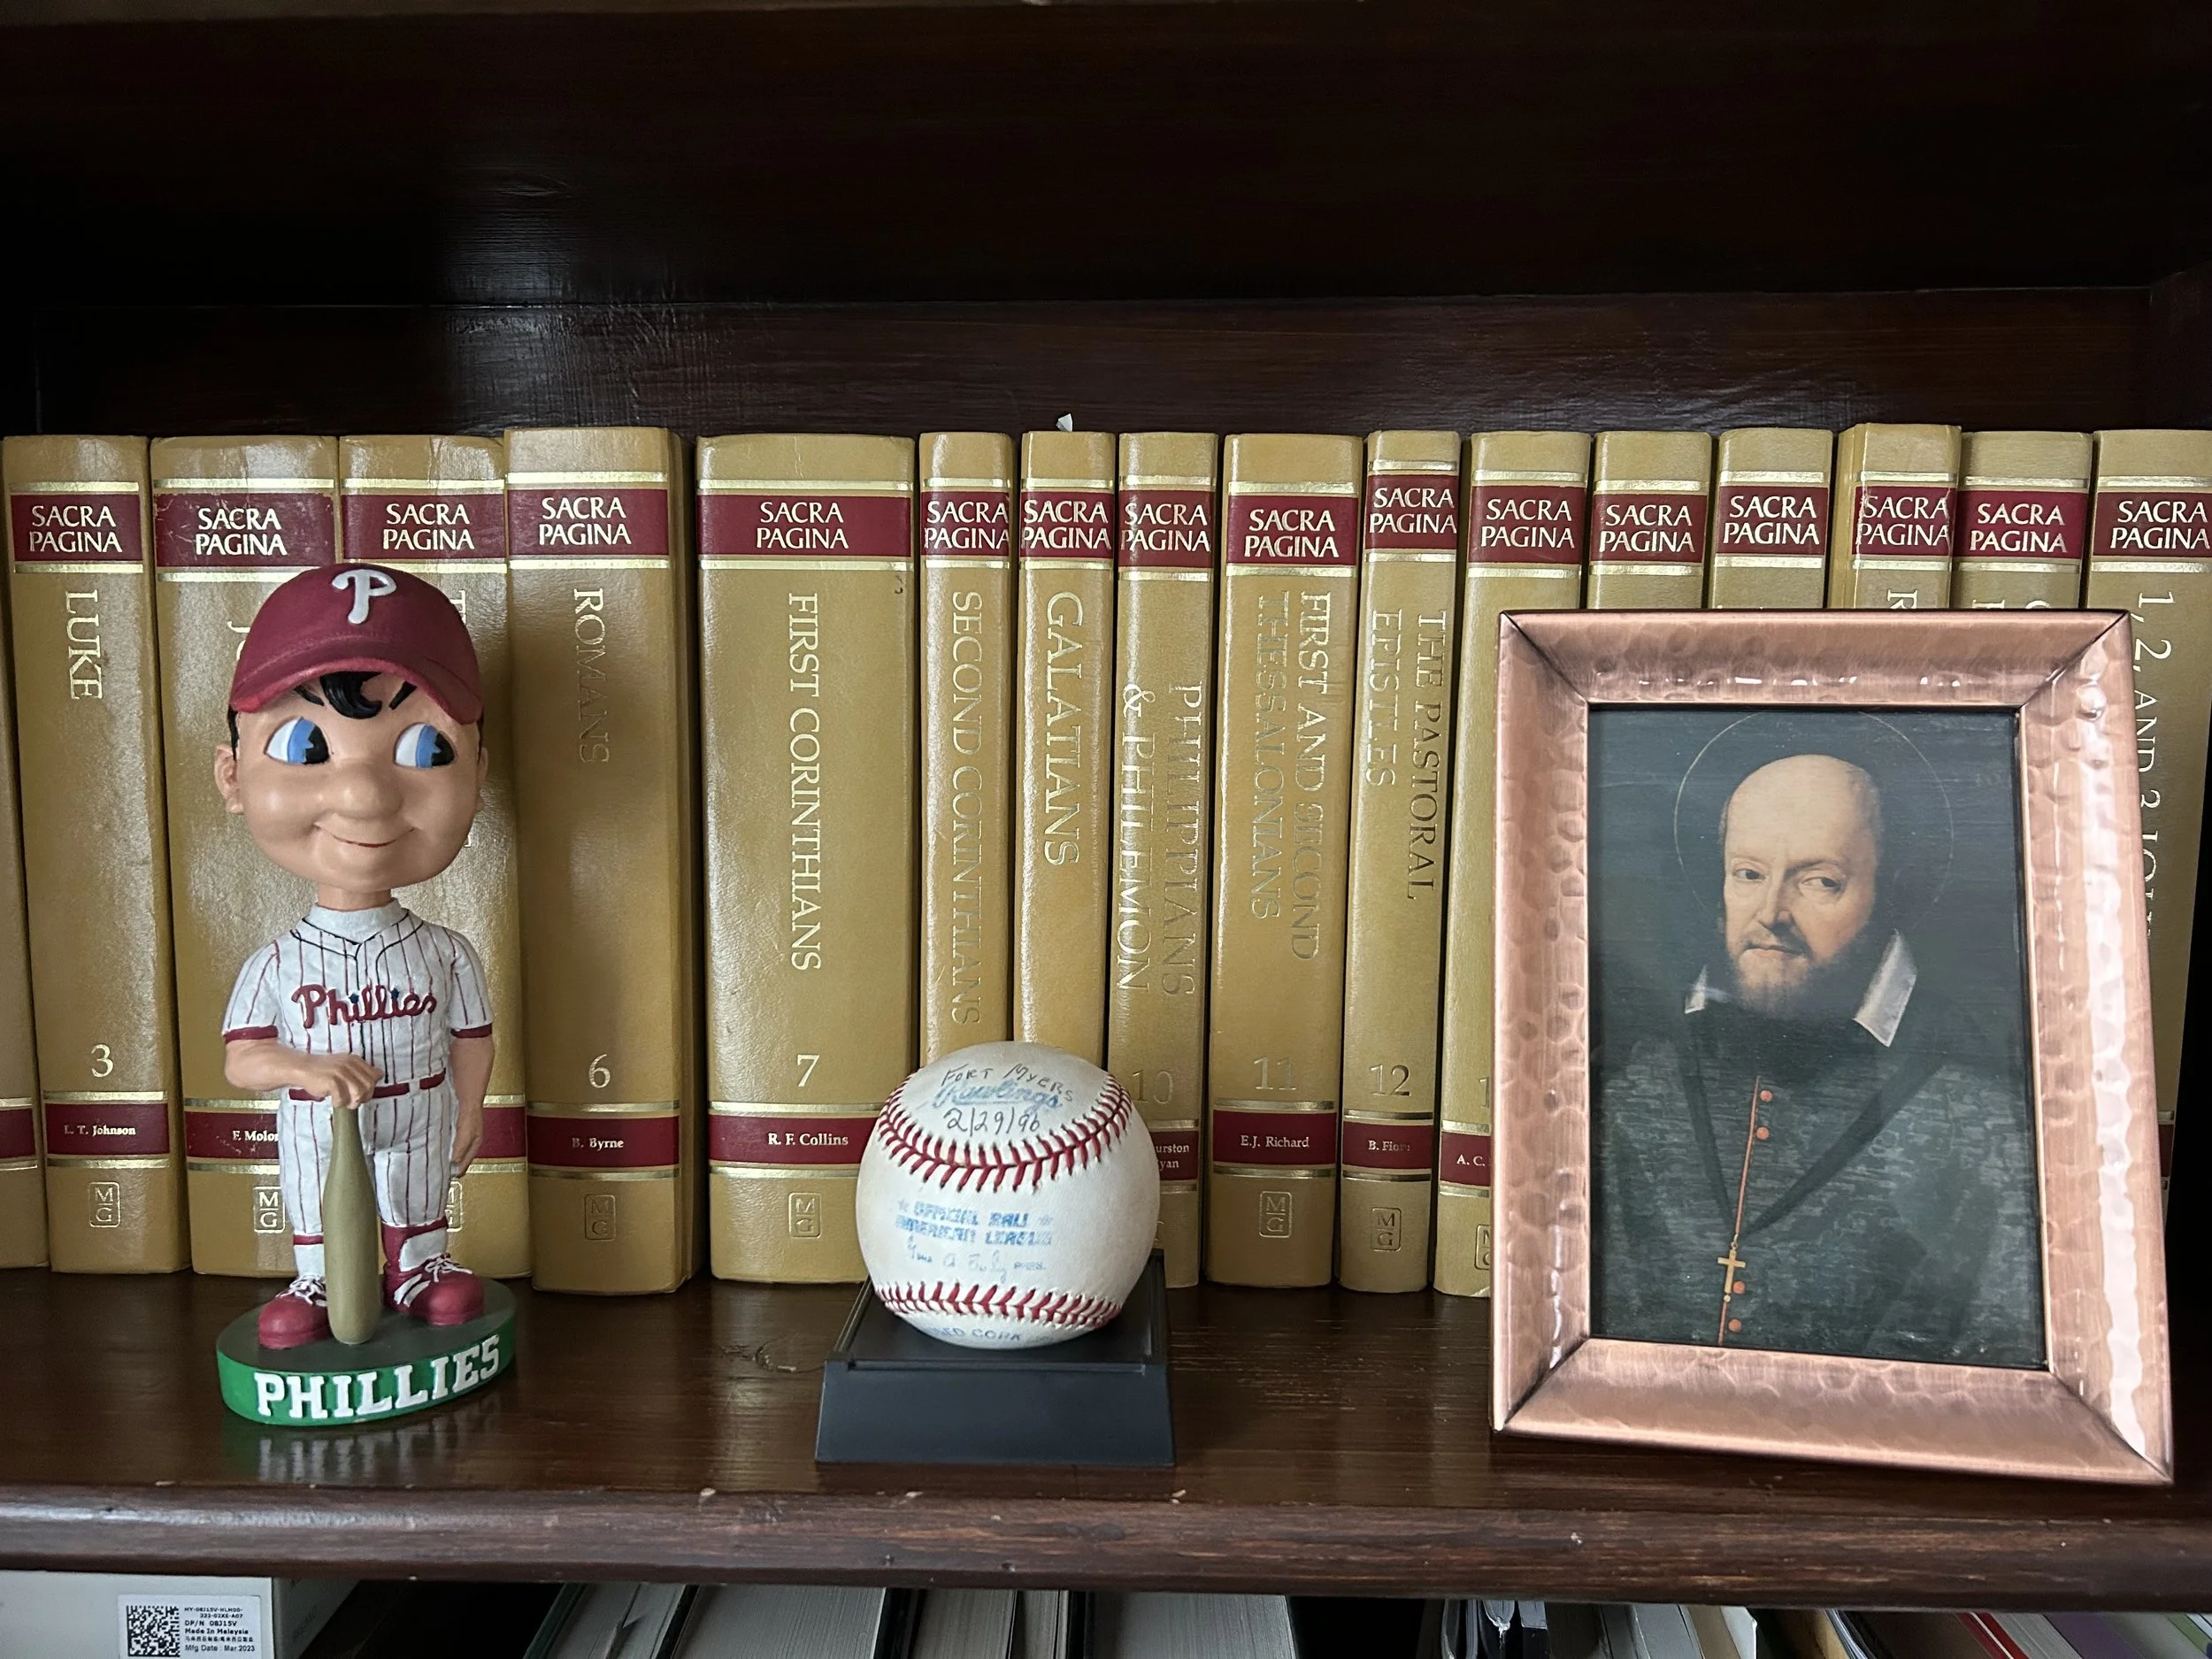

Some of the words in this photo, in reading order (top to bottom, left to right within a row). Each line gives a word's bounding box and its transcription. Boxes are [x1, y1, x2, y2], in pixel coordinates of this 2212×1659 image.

[542, 497, 626, 519] SACRA
[1373, 488, 1454, 508] SACRA
[1730, 496, 1816, 518] SACRA
[1863, 495, 1948, 518] SACRA
[33, 506, 116, 526] SACRA
[197, 507, 281, 530] SACRA
[387, 503, 470, 525] SACRA
[761, 502, 843, 523] SACRA
[927, 501, 1008, 524] SACRA
[1024, 500, 1108, 523] SACRA
[1125, 502, 1207, 526] SACRA
[1249, 510, 1335, 531] SACRA
[1486, 499, 1571, 521] SACRA
[1606, 504, 1692, 526] SACRA
[1978, 503, 2063, 525] SACRA
[2118, 501, 2207, 523] SACRA
[1370, 511, 1456, 533] PAGINA
[1724, 522, 1819, 544] PAGINA
[30, 532, 122, 552] PAGINA
[196, 534, 287, 556] PAGINA
[383, 529, 474, 550] PAGINA
[540, 523, 632, 545] PAGINA
[757, 528, 849, 549] PAGINA
[925, 526, 1010, 550] PAGINA
[1022, 526, 1111, 549] PAGINA
[1121, 528, 1210, 552] PAGINA
[1480, 526, 1574, 548] PAGINA
[1600, 530, 1694, 552] PAGINA
[1857, 522, 1949, 546] PAGINA
[1970, 531, 2066, 552] PAGINA
[2111, 527, 2211, 549] PAGINA
[1245, 535, 1339, 557] PAGINA
[65, 589, 104, 700] LUKE
[787, 592, 820, 697] FIRST
[1297, 590, 1331, 695] FIRST
[1416, 610, 1447, 688] THE
[574, 588, 610, 764] ROMANS
[952, 591, 983, 756] SECOND
[1122, 683, 1156, 718] &
[1365, 609, 1402, 787] EPISTLES
[1044, 591, 1084, 866] GALATIANS
[1251, 590, 1289, 919] THESSALONIANS
[1294, 703, 1327, 793] AND
[1407, 700, 1442, 901] PASTORAL
[789, 707, 821, 971] CORINTHIANS
[1161, 680, 1202, 997] PHILIPPIANS
[1116, 733, 1156, 994] PHILEMON
[1290, 802, 1325, 961] SECOND
[951, 765, 983, 1025] CORINTHIANS
[291, 983, 437, 1029] Phillies
[91, 1044, 114, 1078] 3
[588, 1054, 611, 1088] 6
[796, 1054, 820, 1087] 7
[1254, 1056, 1296, 1090] 11
[1370, 1064, 1411, 1096] 12
[1132, 1069, 1174, 1104] 10
[92, 1124, 136, 1136] Johnson
[767, 1133, 781, 1146] R.
[785, 1133, 796, 1146] F.
[799, 1133, 849, 1146] Collins
[1240, 1134, 1261, 1148] E.J.
[1265, 1136, 1310, 1148] Richard
[588, 1137, 625, 1150] Byrne
[1154, 1143, 1190, 1154] urston
[1368, 1140, 1379, 1150] B.
[1456, 1154, 1470, 1166] A.
[1473, 1156, 1486, 1167] C.
[258, 1192, 279, 1207] M
[254, 1334, 502, 1419] PHILLIES
